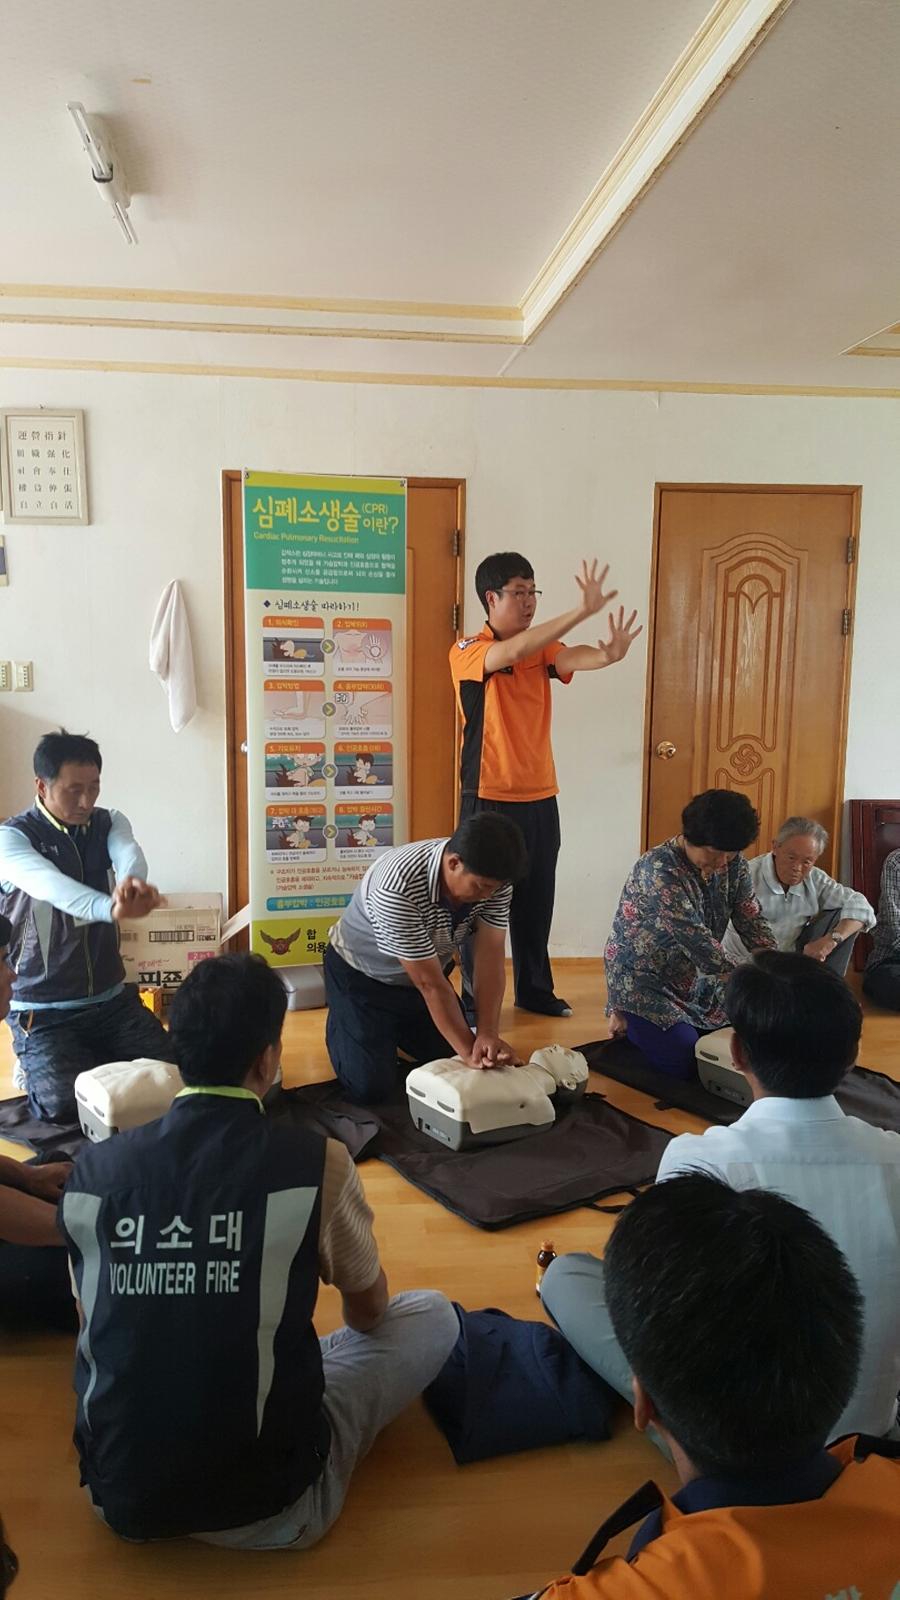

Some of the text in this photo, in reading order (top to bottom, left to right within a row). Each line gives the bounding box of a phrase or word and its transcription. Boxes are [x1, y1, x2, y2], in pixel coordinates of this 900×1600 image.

[252, 496, 388, 533] 심폐소생술 (CPR)
[362, 516, 399, 535] 이란?
[254, 532, 279, 540] Cardiac
[281, 532, 318, 543] Pulmonary
[275, 599, 359, 612] 심폐소생술 따라하기!
[138, 971, 183, 988] 피죤
[110, 1210, 243, 1255] 의소대
[110, 1261, 240, 1295] VOLUNTEER FIRE
